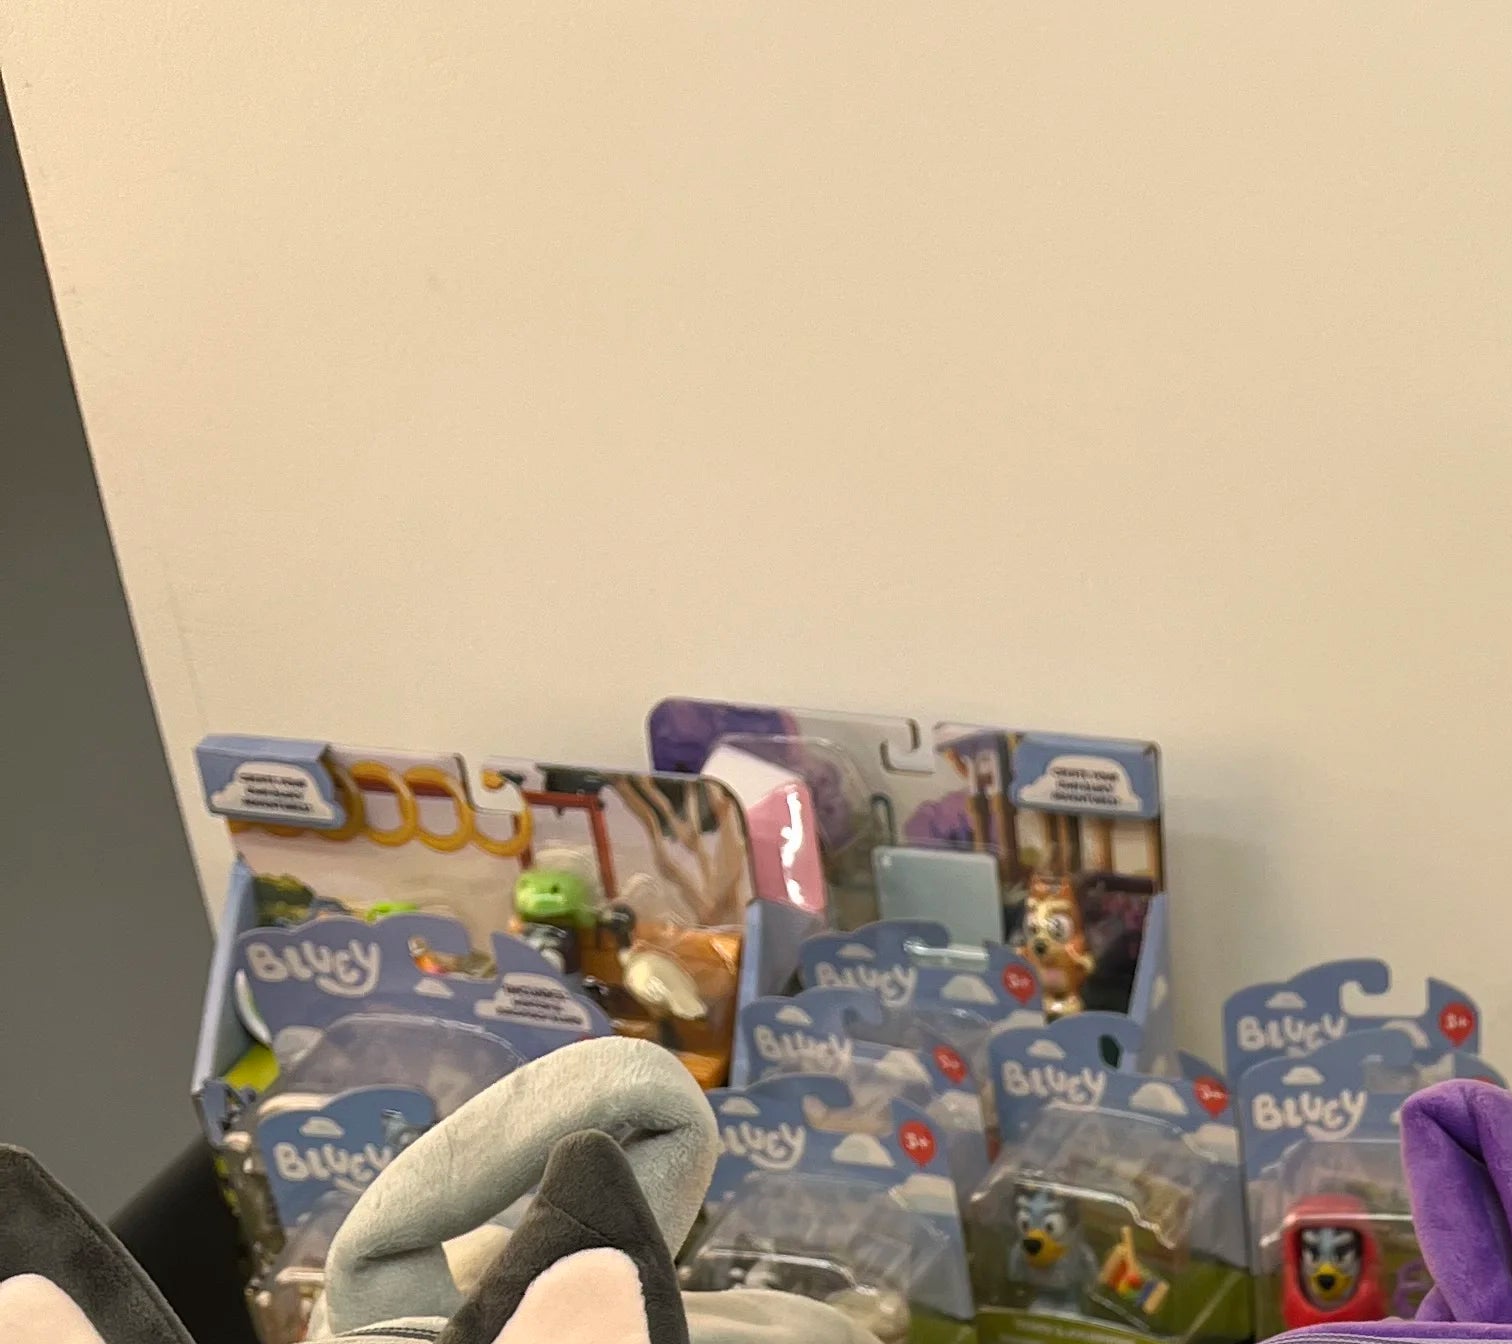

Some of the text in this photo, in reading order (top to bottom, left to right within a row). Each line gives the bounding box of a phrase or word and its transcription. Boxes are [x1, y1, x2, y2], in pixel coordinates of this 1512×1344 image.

[246, 939, 381, 997] BLUEY
[1003, 1061, 1107, 1110] BLUEY
[1252, 1090, 1368, 1141] BLUEY
[719, 1121, 807, 1170] LUEY
